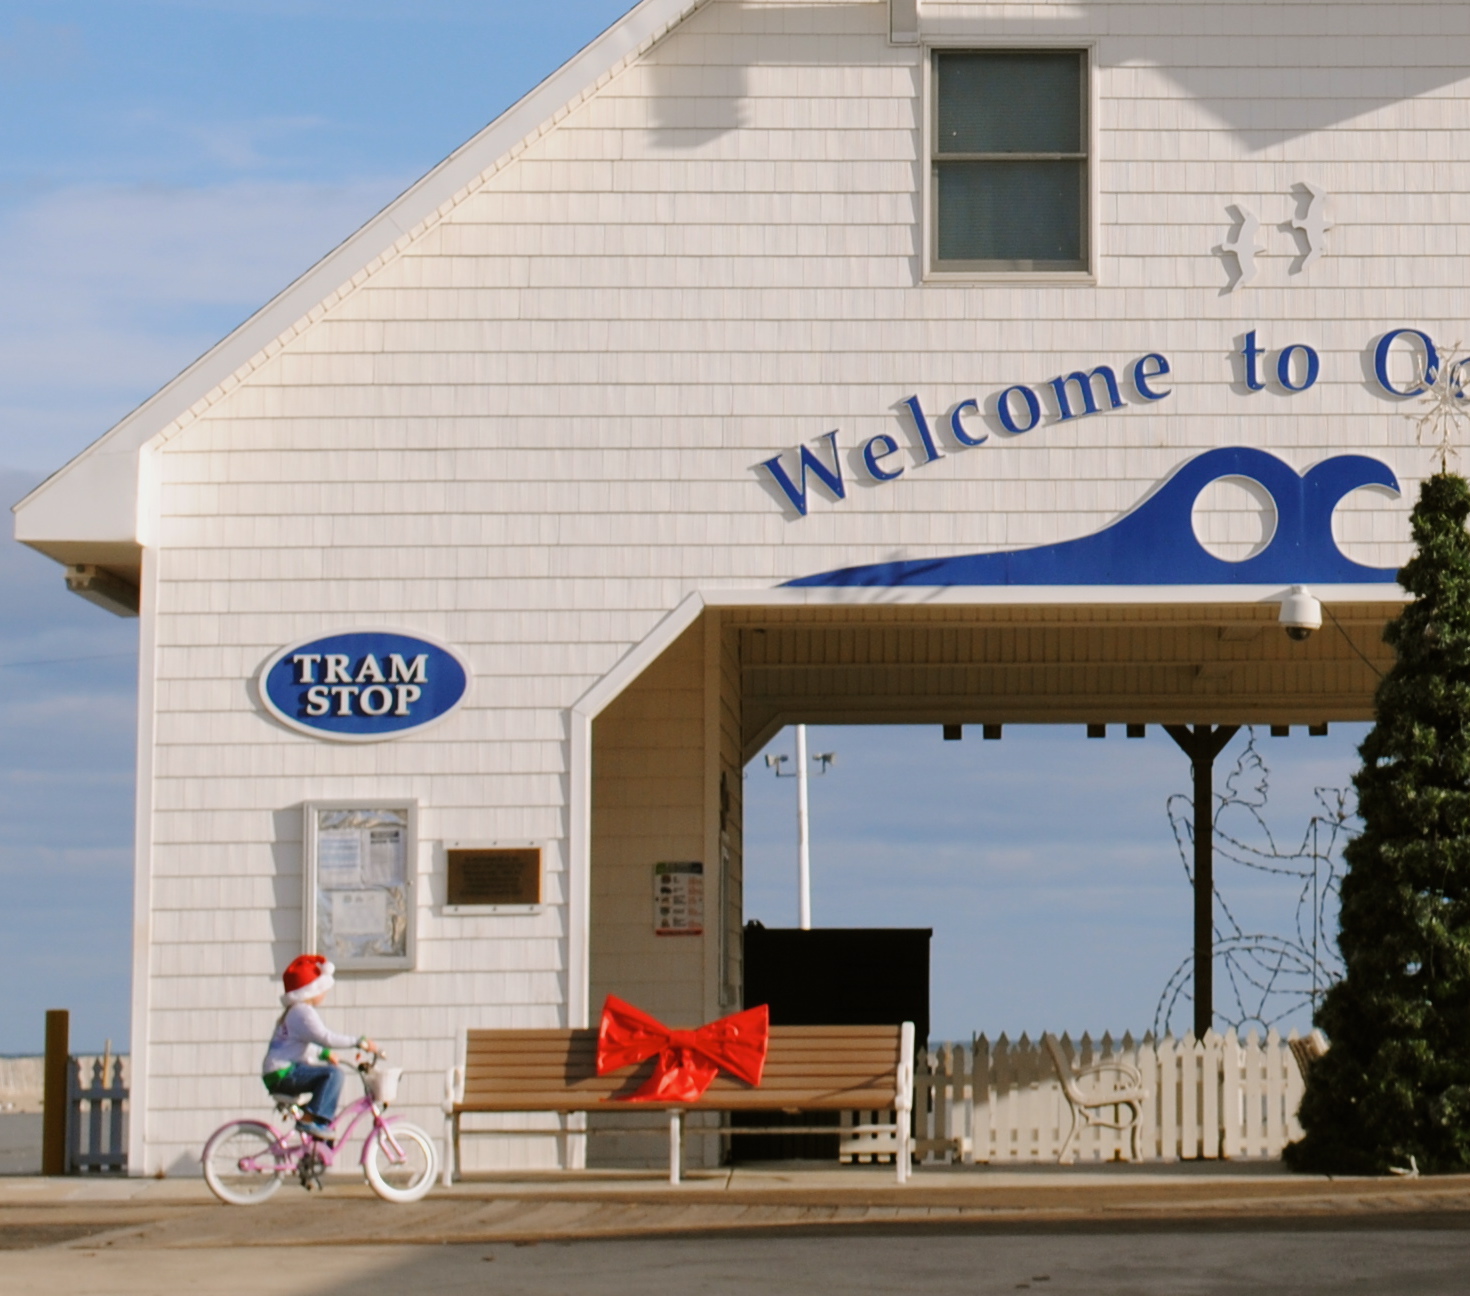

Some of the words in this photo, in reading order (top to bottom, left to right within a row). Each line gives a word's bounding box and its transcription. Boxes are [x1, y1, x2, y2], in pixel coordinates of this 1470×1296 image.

[761, 350, 1171, 518] Welcome
[1241, 330, 1321, 393] to
[293, 653, 428, 683] TRAM
[306, 684, 421, 716] STOP
